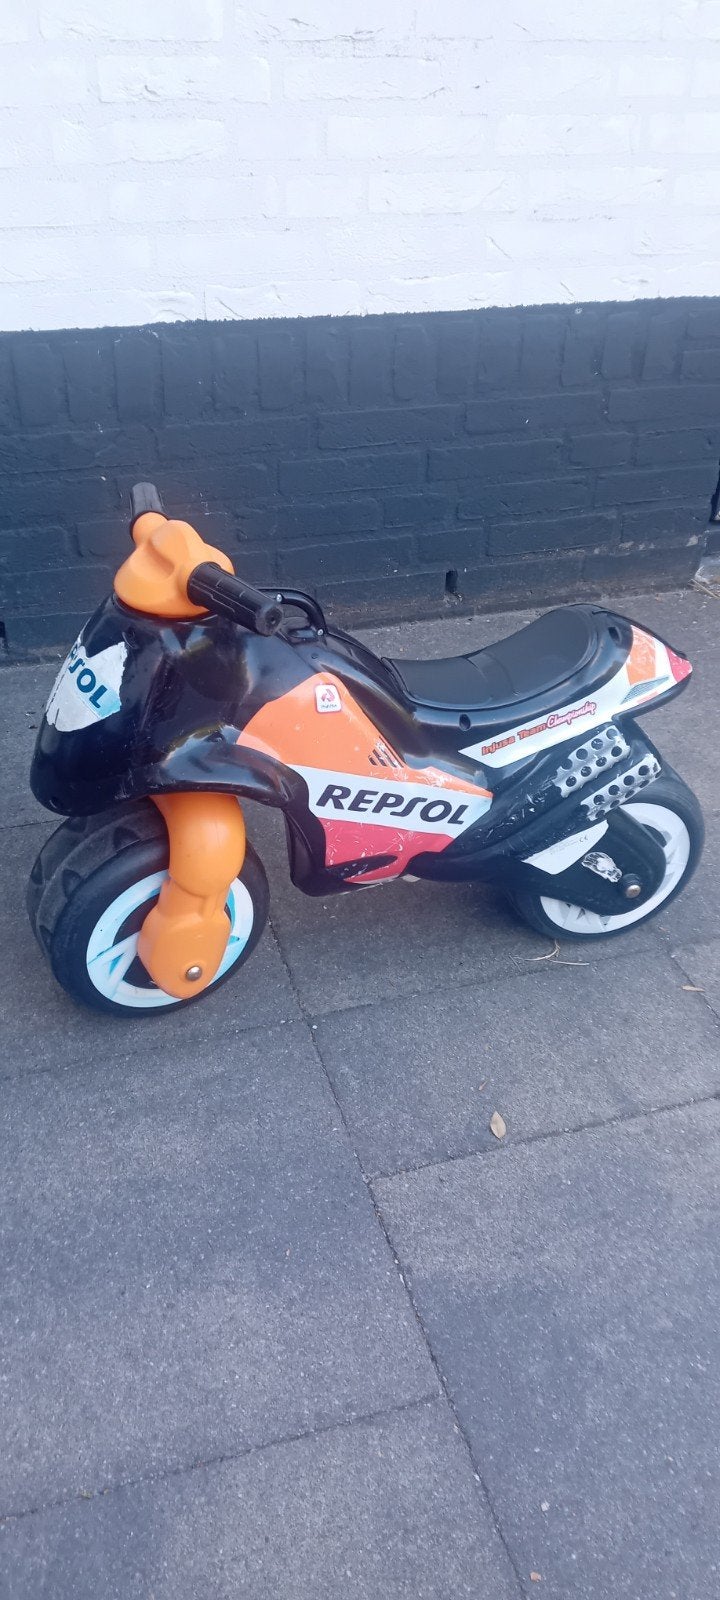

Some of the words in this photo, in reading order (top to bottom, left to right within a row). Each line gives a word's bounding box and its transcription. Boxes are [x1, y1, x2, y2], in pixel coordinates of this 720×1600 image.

[517, 722, 548, 740] Team
[547, 701, 597, 729] Championship
[315, 784, 469, 825] REPSOL
